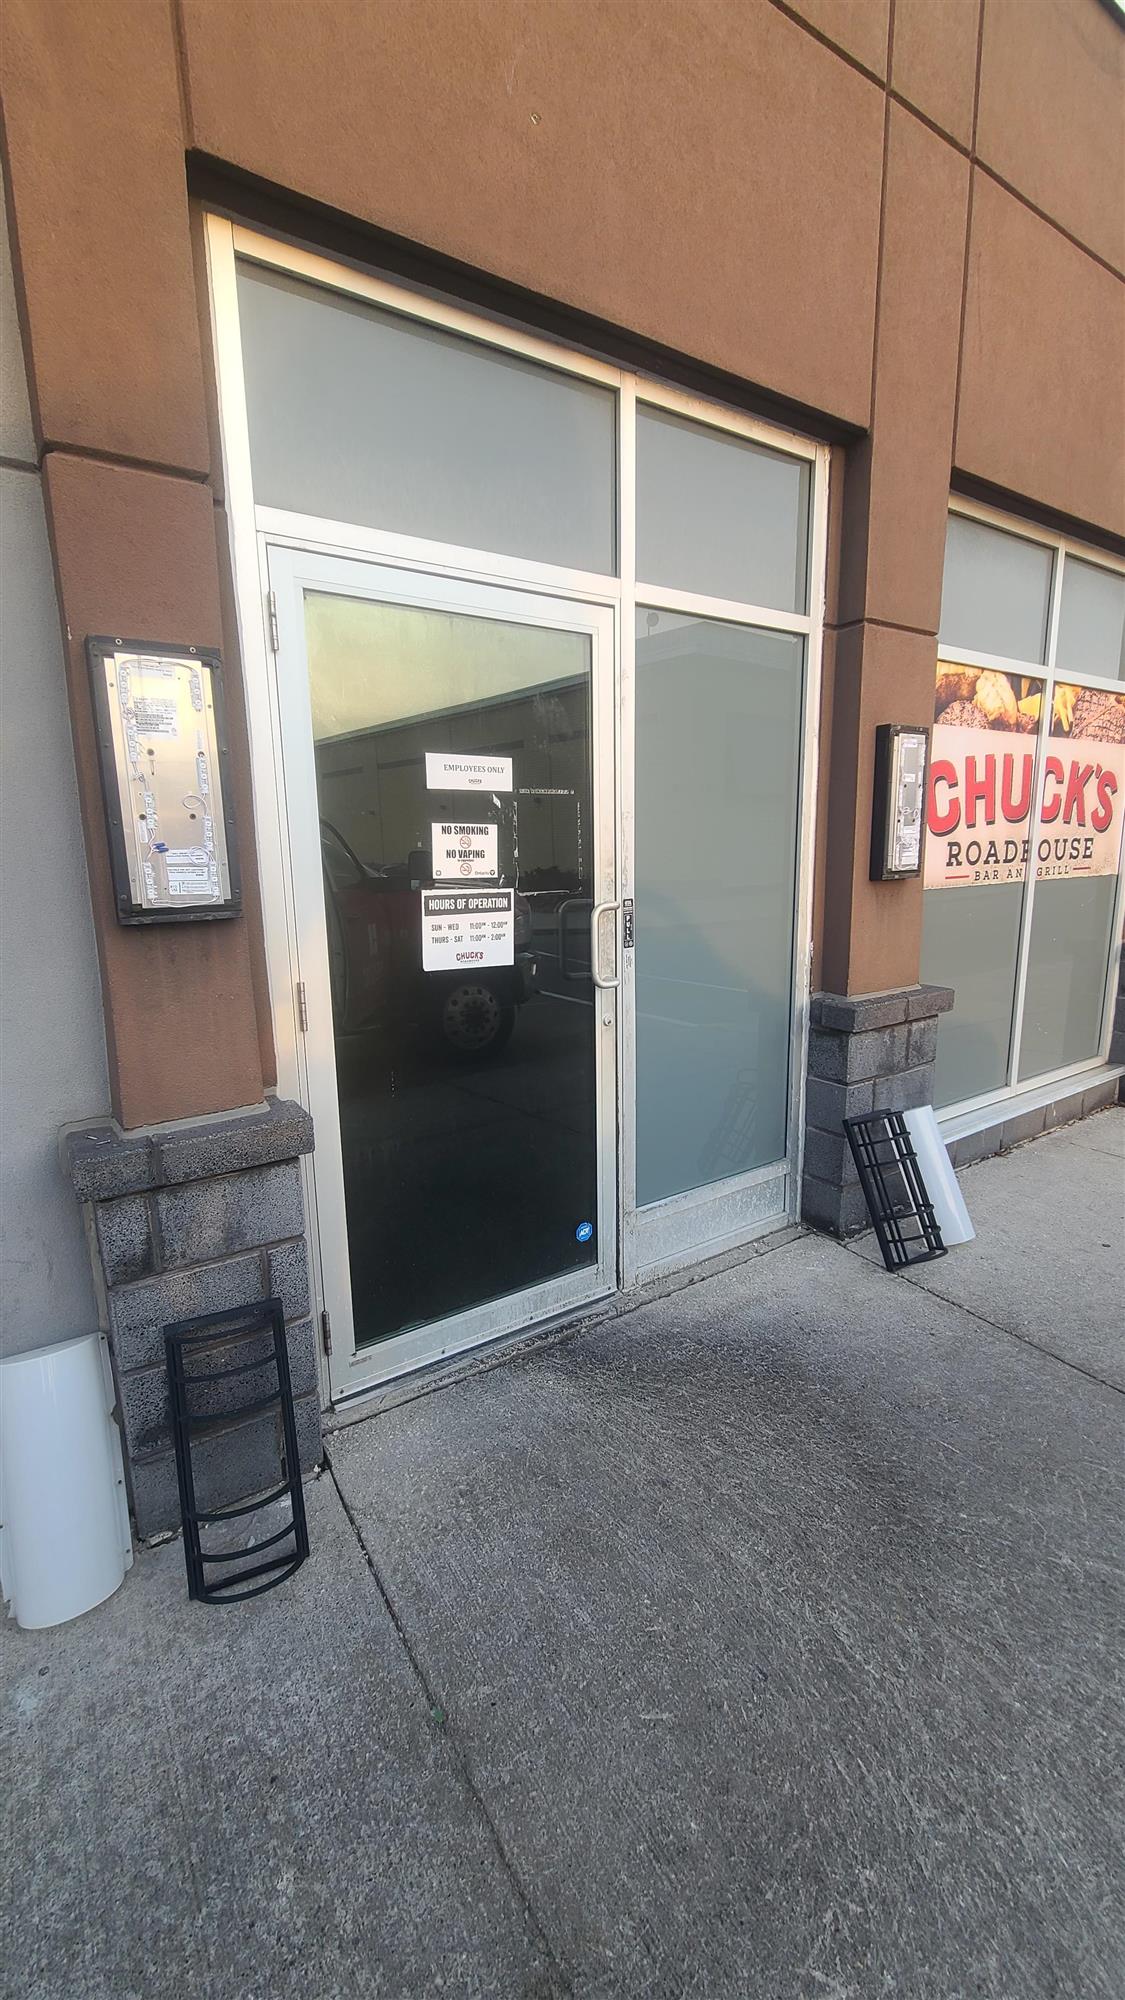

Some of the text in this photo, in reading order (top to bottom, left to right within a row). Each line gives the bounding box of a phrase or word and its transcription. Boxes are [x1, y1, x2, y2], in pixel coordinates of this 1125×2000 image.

[444, 764, 486, 773] EMPLOYEES
[927, 753, 1118, 838] CHUCK'S
[441, 825, 489, 836] NO SMOKING
[446, 849, 486, 858] NO VAPING
[974, 865, 1070, 881] BAR AN GRILL
[428, 897, 508, 910] HOURS OF OPERATION
[432, 924, 442, 932] SUN
[448, 923, 460, 931] WED
[432, 936, 449, 944] THURS
